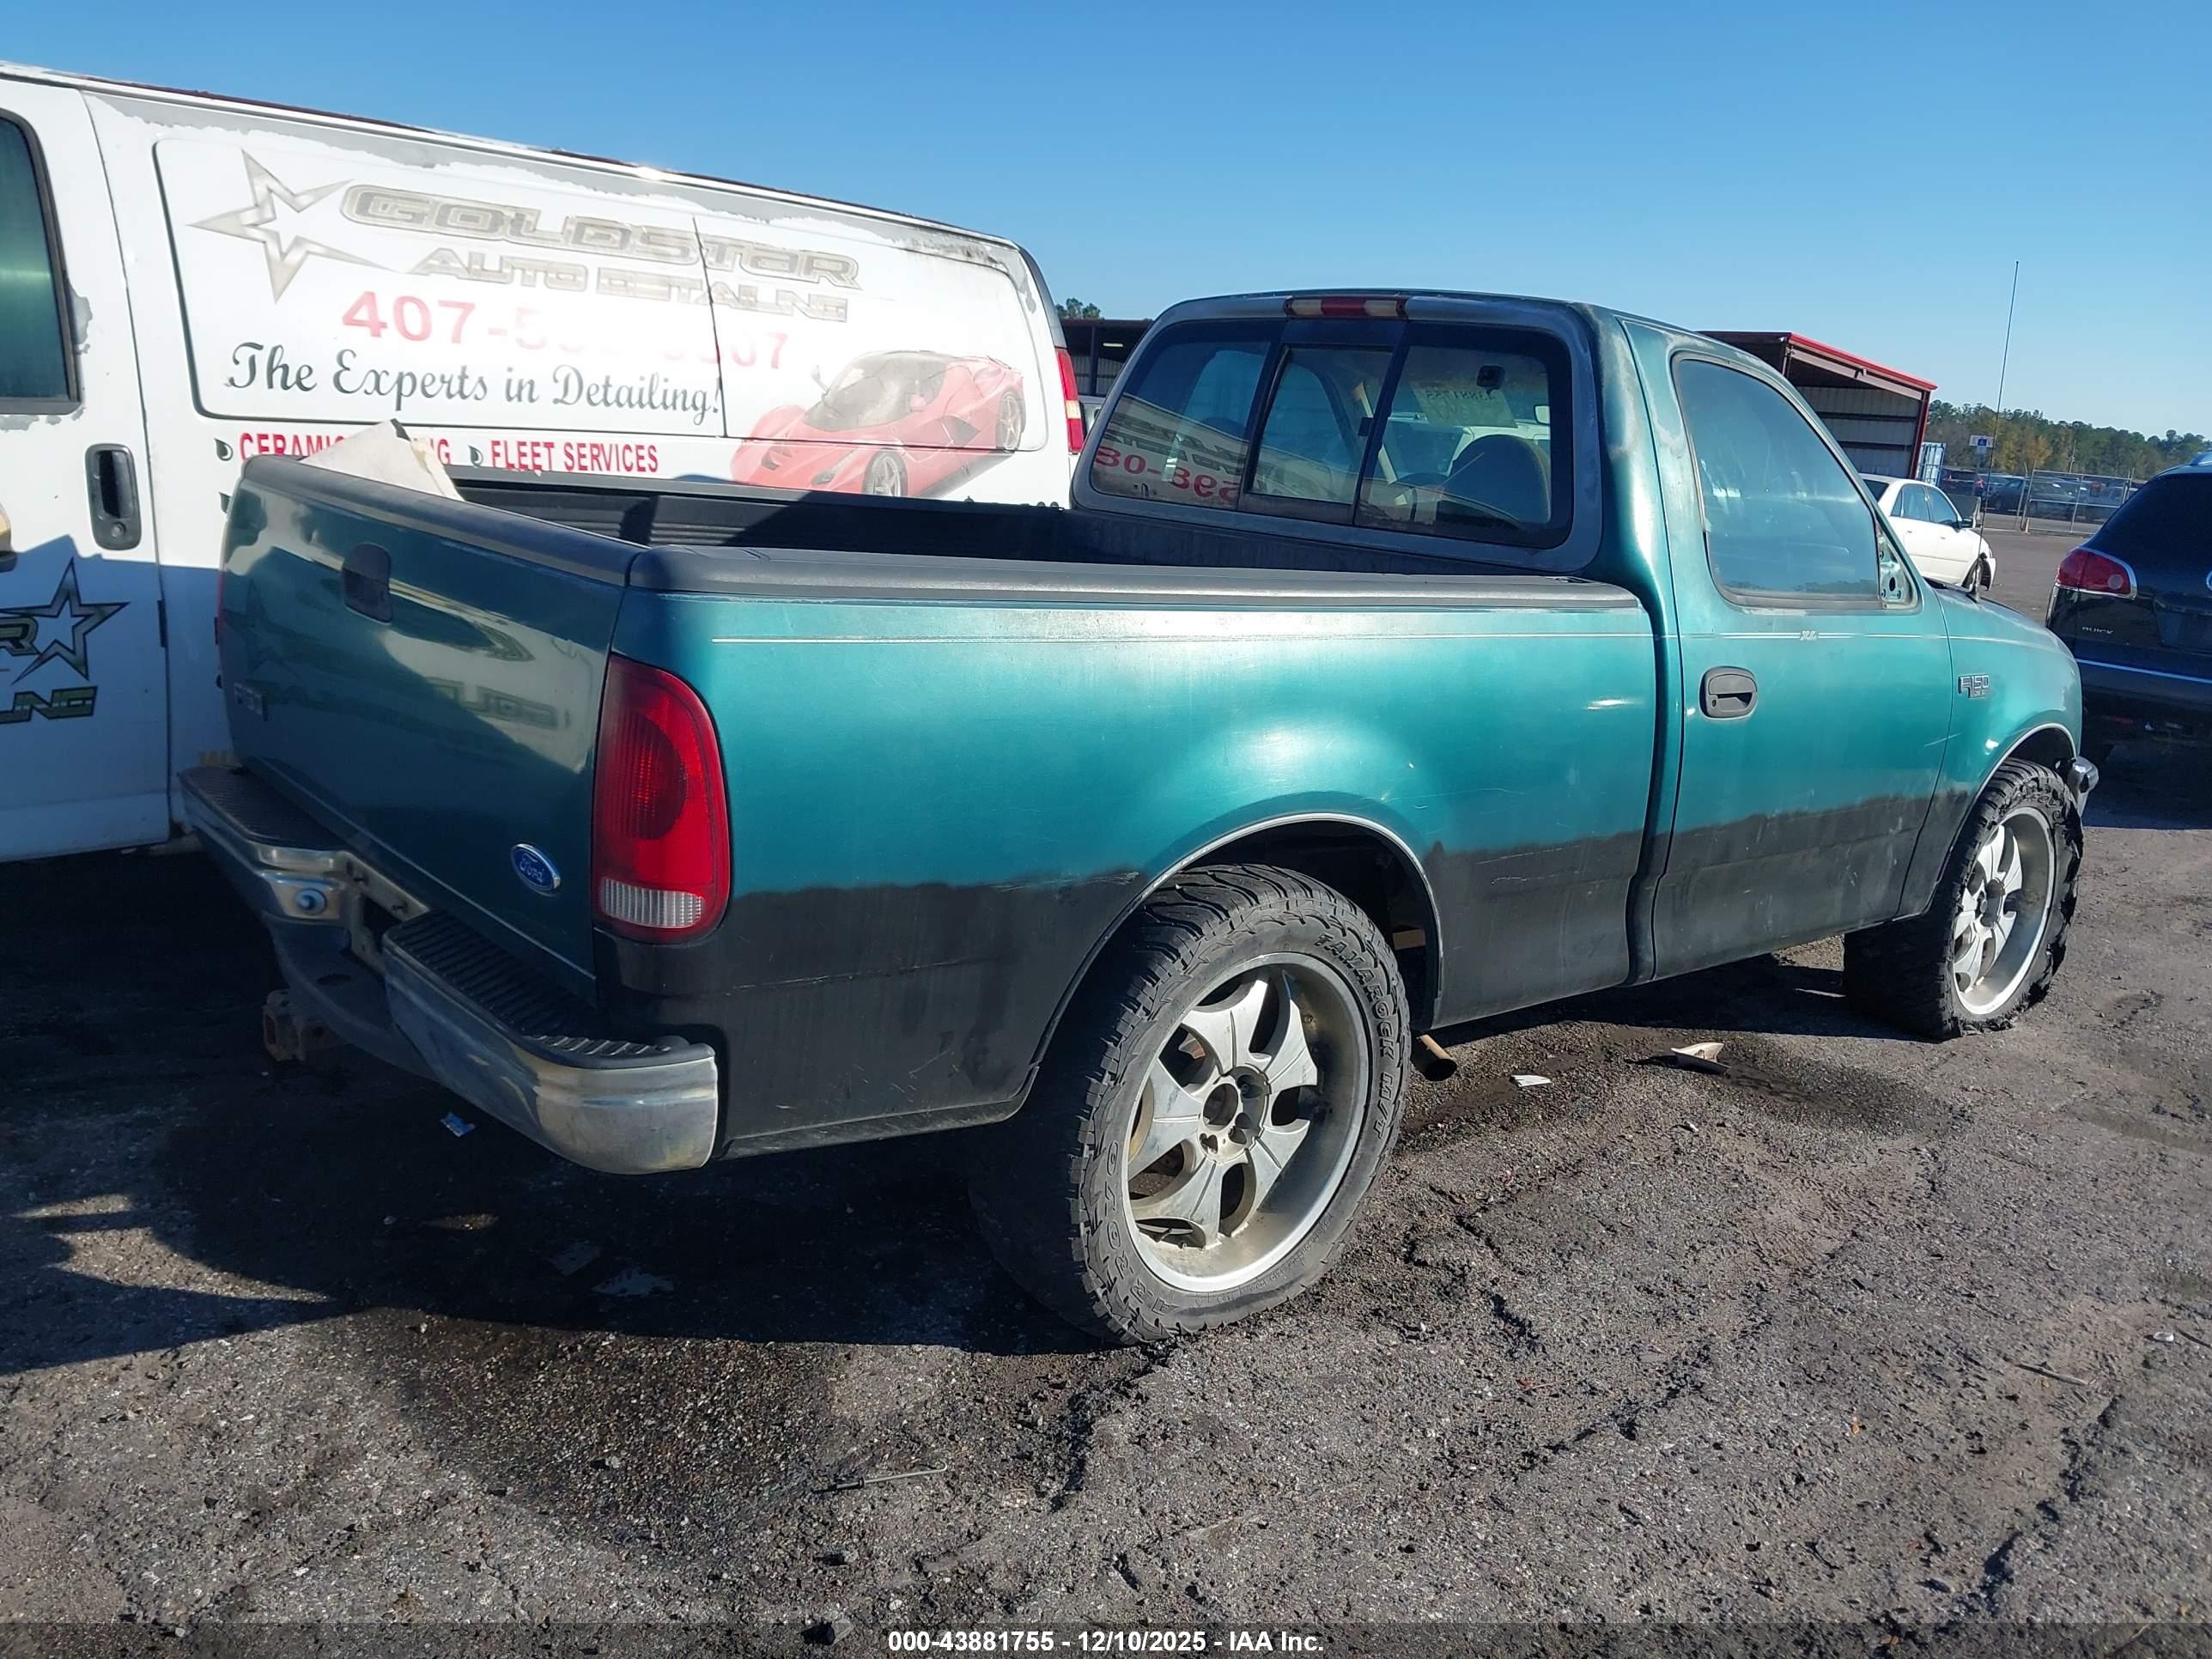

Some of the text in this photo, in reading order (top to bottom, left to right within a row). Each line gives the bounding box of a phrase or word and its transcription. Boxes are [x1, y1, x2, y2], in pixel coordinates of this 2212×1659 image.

[406, 246, 587, 292] AUTO
[225, 342, 720, 425] The Experts in Detailing!
[491, 439, 659, 472] FLEET SERVICES
